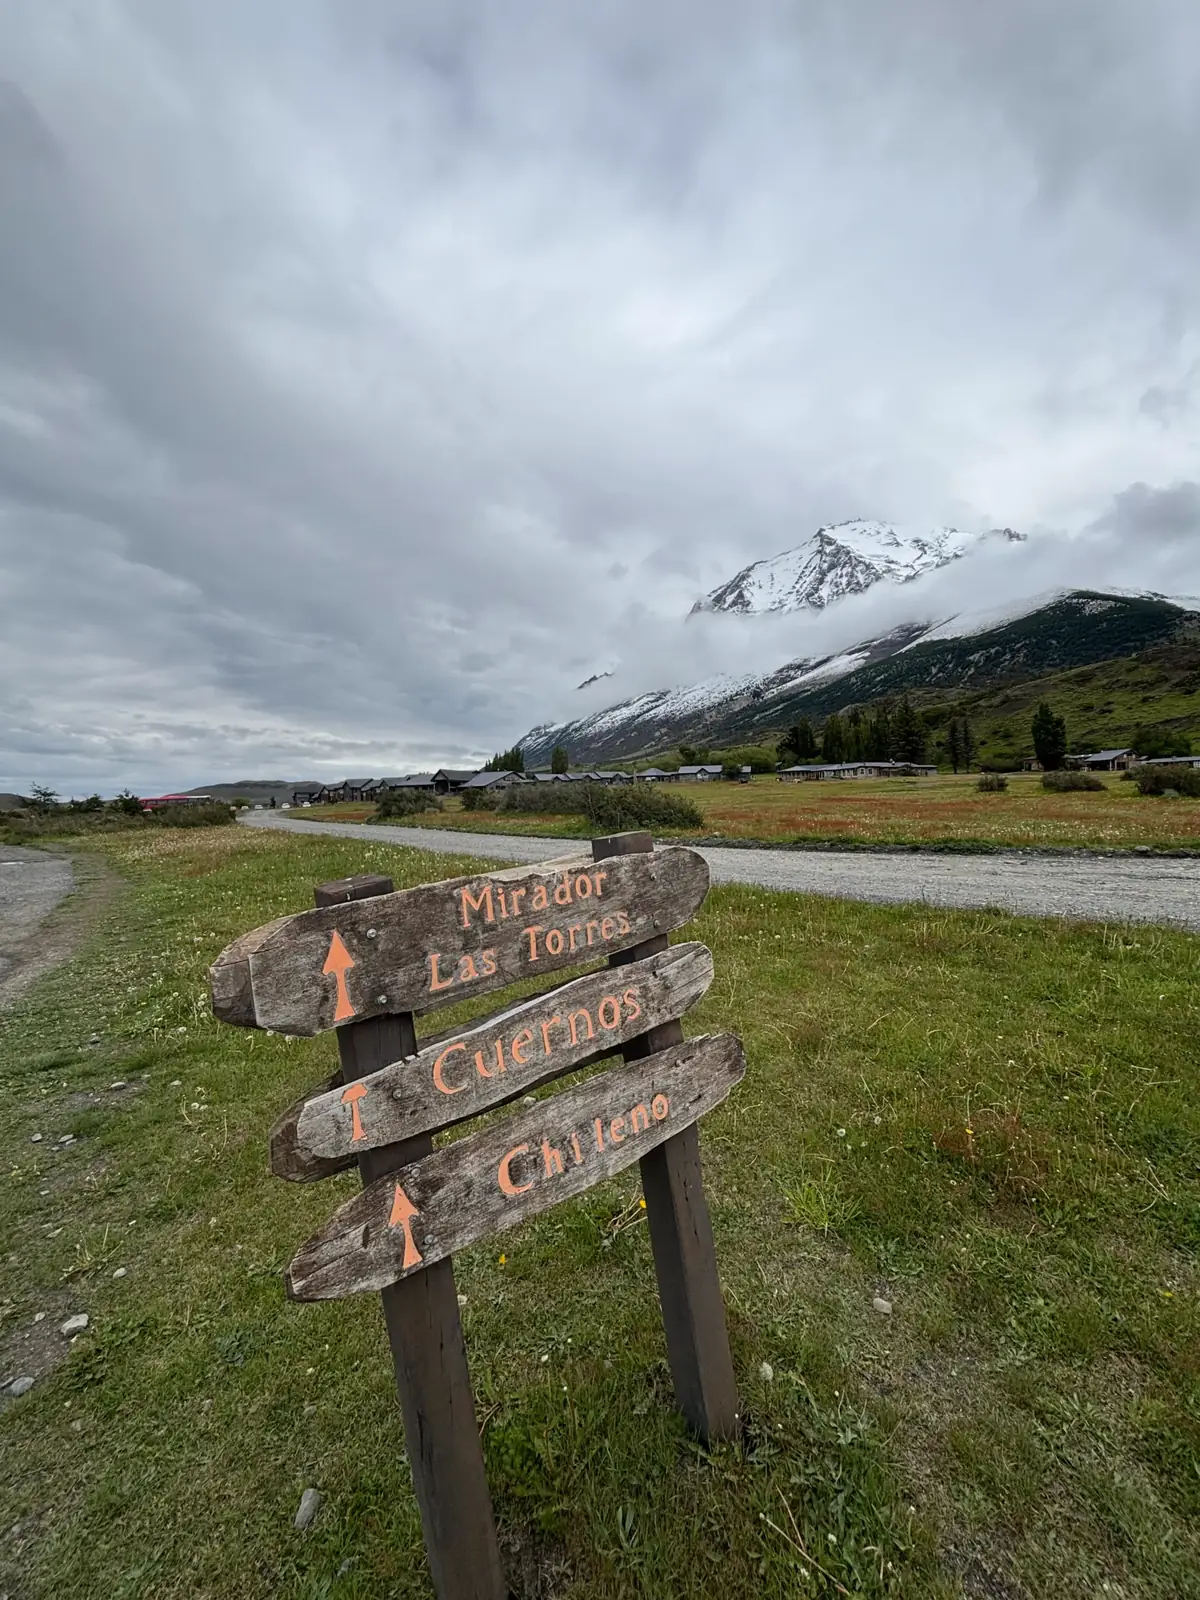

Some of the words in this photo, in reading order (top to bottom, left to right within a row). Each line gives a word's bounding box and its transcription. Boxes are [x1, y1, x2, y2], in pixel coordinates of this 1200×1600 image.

[460, 871, 608, 929] Mirador
[429, 949, 497, 992] Las
[523, 910, 630, 963] Torres
[432, 986, 642, 1095] Cuernos
[497, 1093, 670, 1197] Chileno
